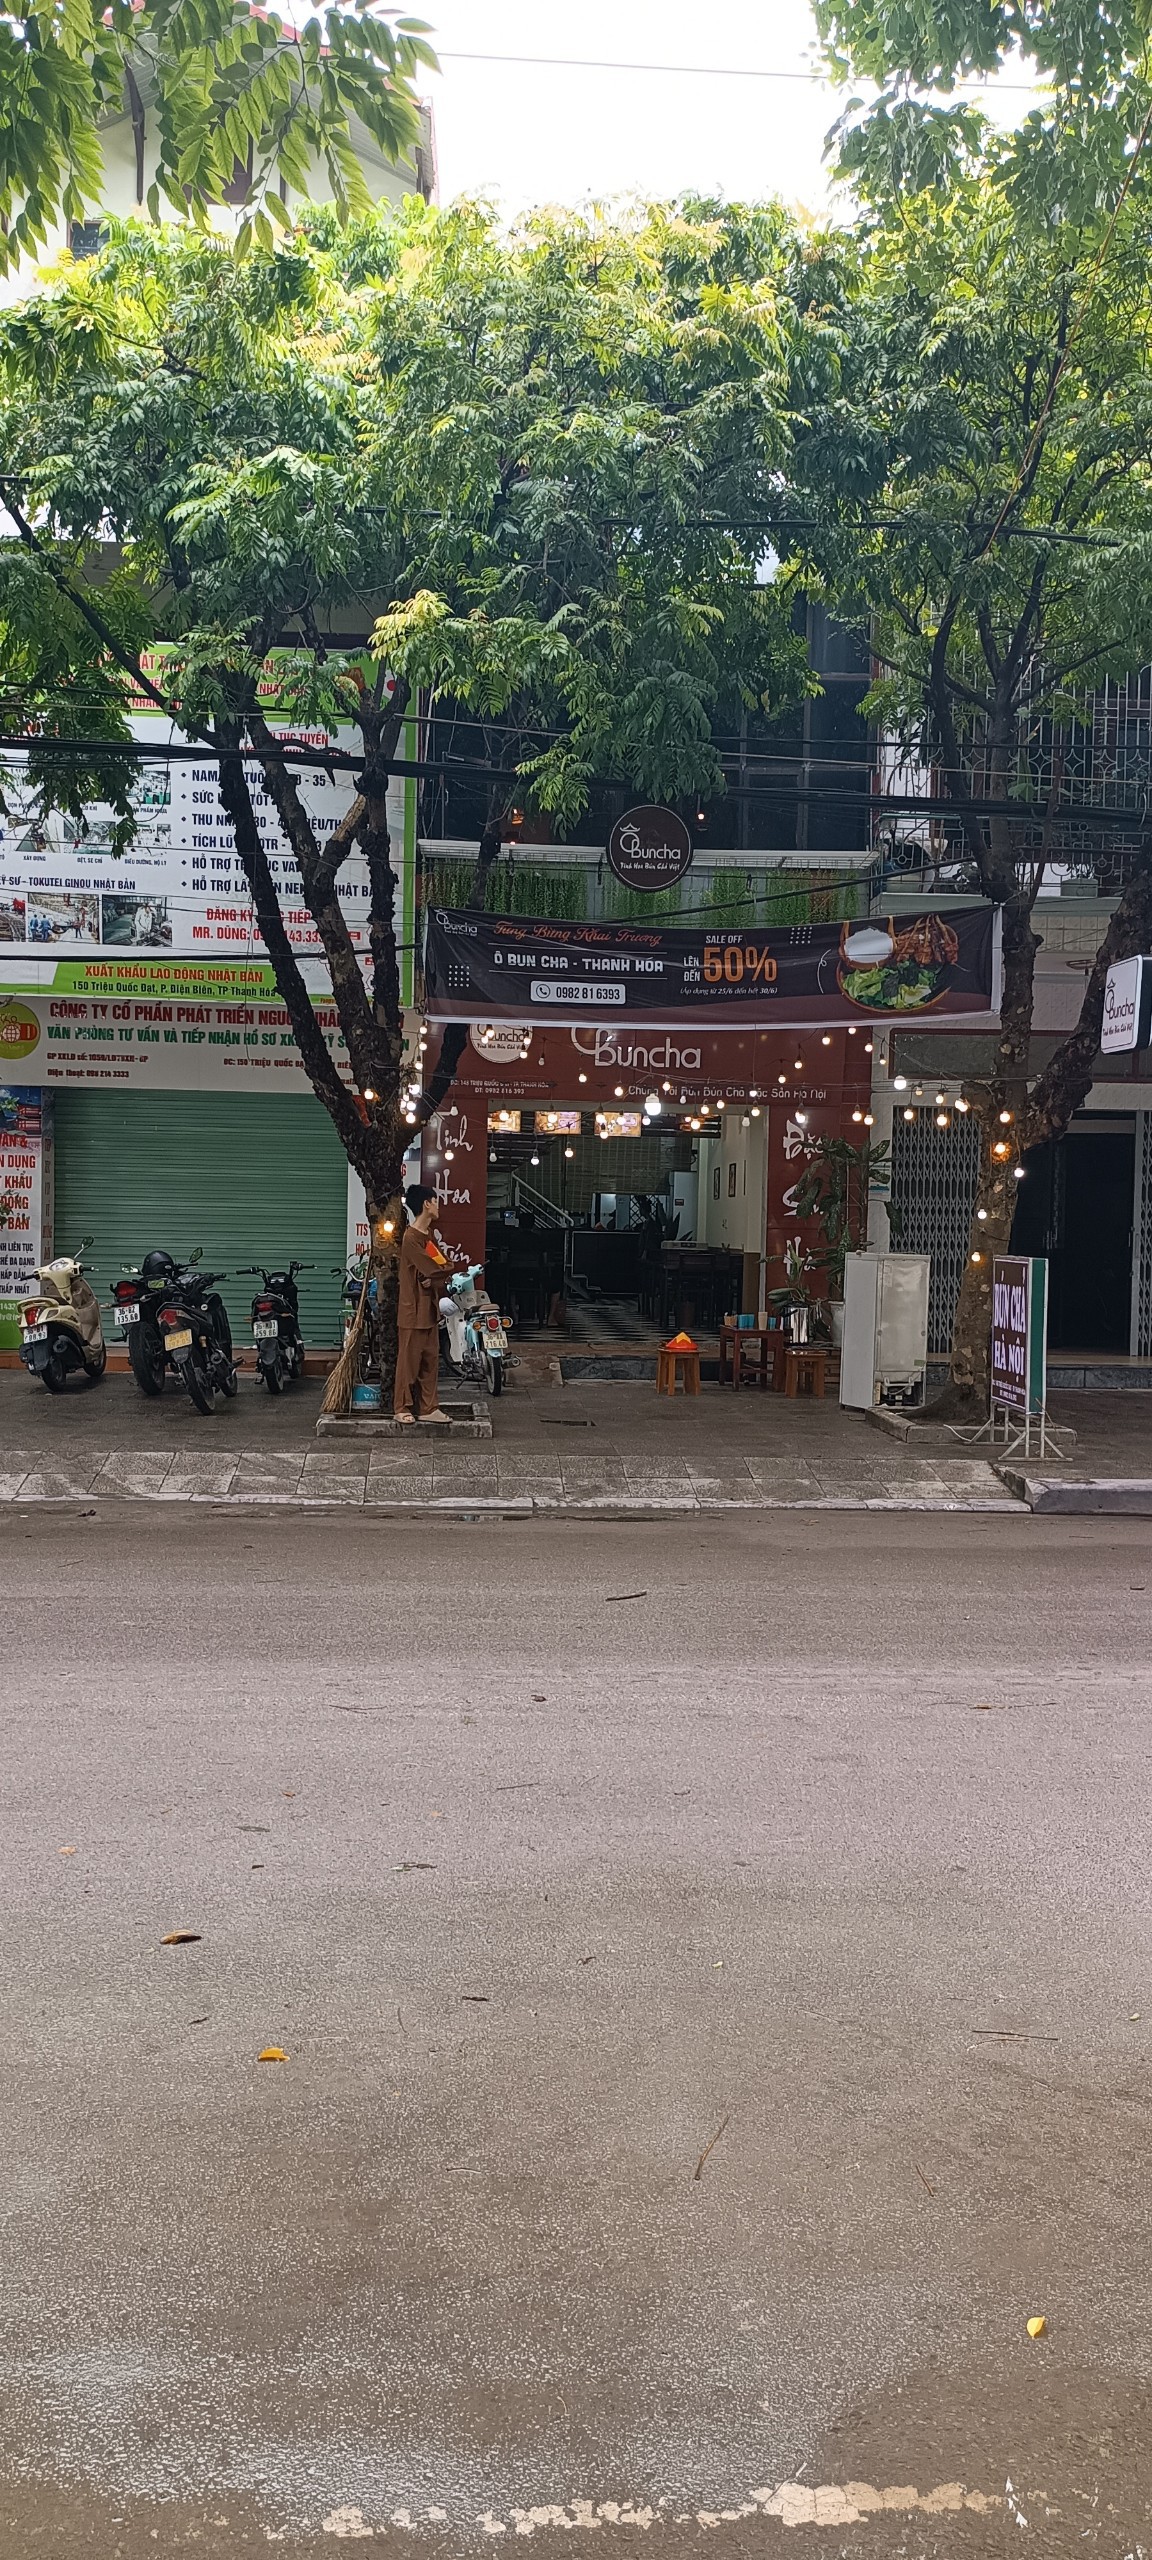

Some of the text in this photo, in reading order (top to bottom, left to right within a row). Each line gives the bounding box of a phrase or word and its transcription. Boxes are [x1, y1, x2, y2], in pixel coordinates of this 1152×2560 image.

[299, 729, 329, 744] TUYỂN
[313, 775, 326, 787] 35
[192, 791, 214, 804] SỨC
[192, 813, 213, 826] THU
[192, 832, 234, 848] TÍCH LŨ
[192, 852, 207, 869] HỖ
[210, 857, 231, 873] TRỢ
[9, 875, 136, 891] SƯ TOKUTEI GINOU NHẬT BẢN
[192, 874, 207, 891] HỖ
[210, 879, 231, 895] TRỢ
[207, 906, 236, 921] ĐĂNG
[288, 908, 312, 924] TIẾP
[192, 925, 250, 940] MR. DŨNG:
[705, 935, 743, 944] SALE OFF
[494, 950, 664, 973] Ô BUN CHA THANH HÓA
[683, 945, 778, 983] LÊN 50%
[85, 962, 263, 984] XUẤT KHẨU LAO ĐỘNG NHẬT BẢN
[683, 968, 701, 982] ĐẾN
[72, 981, 89, 991] 150
[91, 980, 114, 992] Triệu
[116, 981, 138, 993] Quốc
[141, 983, 158, 995] Đạt,
[160, 984, 168, 993] P.
[170, 983, 191, 996] Điện
[218, 986, 228, 996] TP
[230, 986, 257, 997] Thanh
[260, 985, 276, 998] Hóa
[555, 986, 580, 1000] 0982
[596, 988, 621, 1001] 6393
[718, 987, 733, 995] 25/6
[760, 987, 778, 995] 30/6)
[50, 998, 254, 1025] CÔNG TY CỔ PHẦN PHÁT TRIỂN
[47, 1022, 71, 1039] VĂN
[74, 1024, 114, 1041] PHÒNG
[118, 1026, 134, 1042] TƯ
[137, 1024, 161, 1043] VẤN
[163, 1025, 178, 1043] VÀ
[181, 1026, 206, 1044] TIẾP
[208, 1030, 241, 1048] NHẬN
[262, 1031, 277, 1046] SƠ
[237, 1058, 248, 1066] 150
[251, 1057, 271, 1069] TRIỆU
[274, 1057, 294, 1067] QUỐC
[703, 1086, 722, 1097] Bún
[19, 1134, 28, 1149] &
[8, 1154, 36, 1171] DỤNG
[5, 1171, 32, 1190] KHẨU
[356, 1223, 369, 1237] TTS
[8, 1241, 33, 1253] LIÊN TỤC
[15, 1282, 30, 1294] NHẤT
[994, 1266, 1026, 1334] BÚN CHẢ
[994, 1333, 1025, 1383] HÀ NỘI
